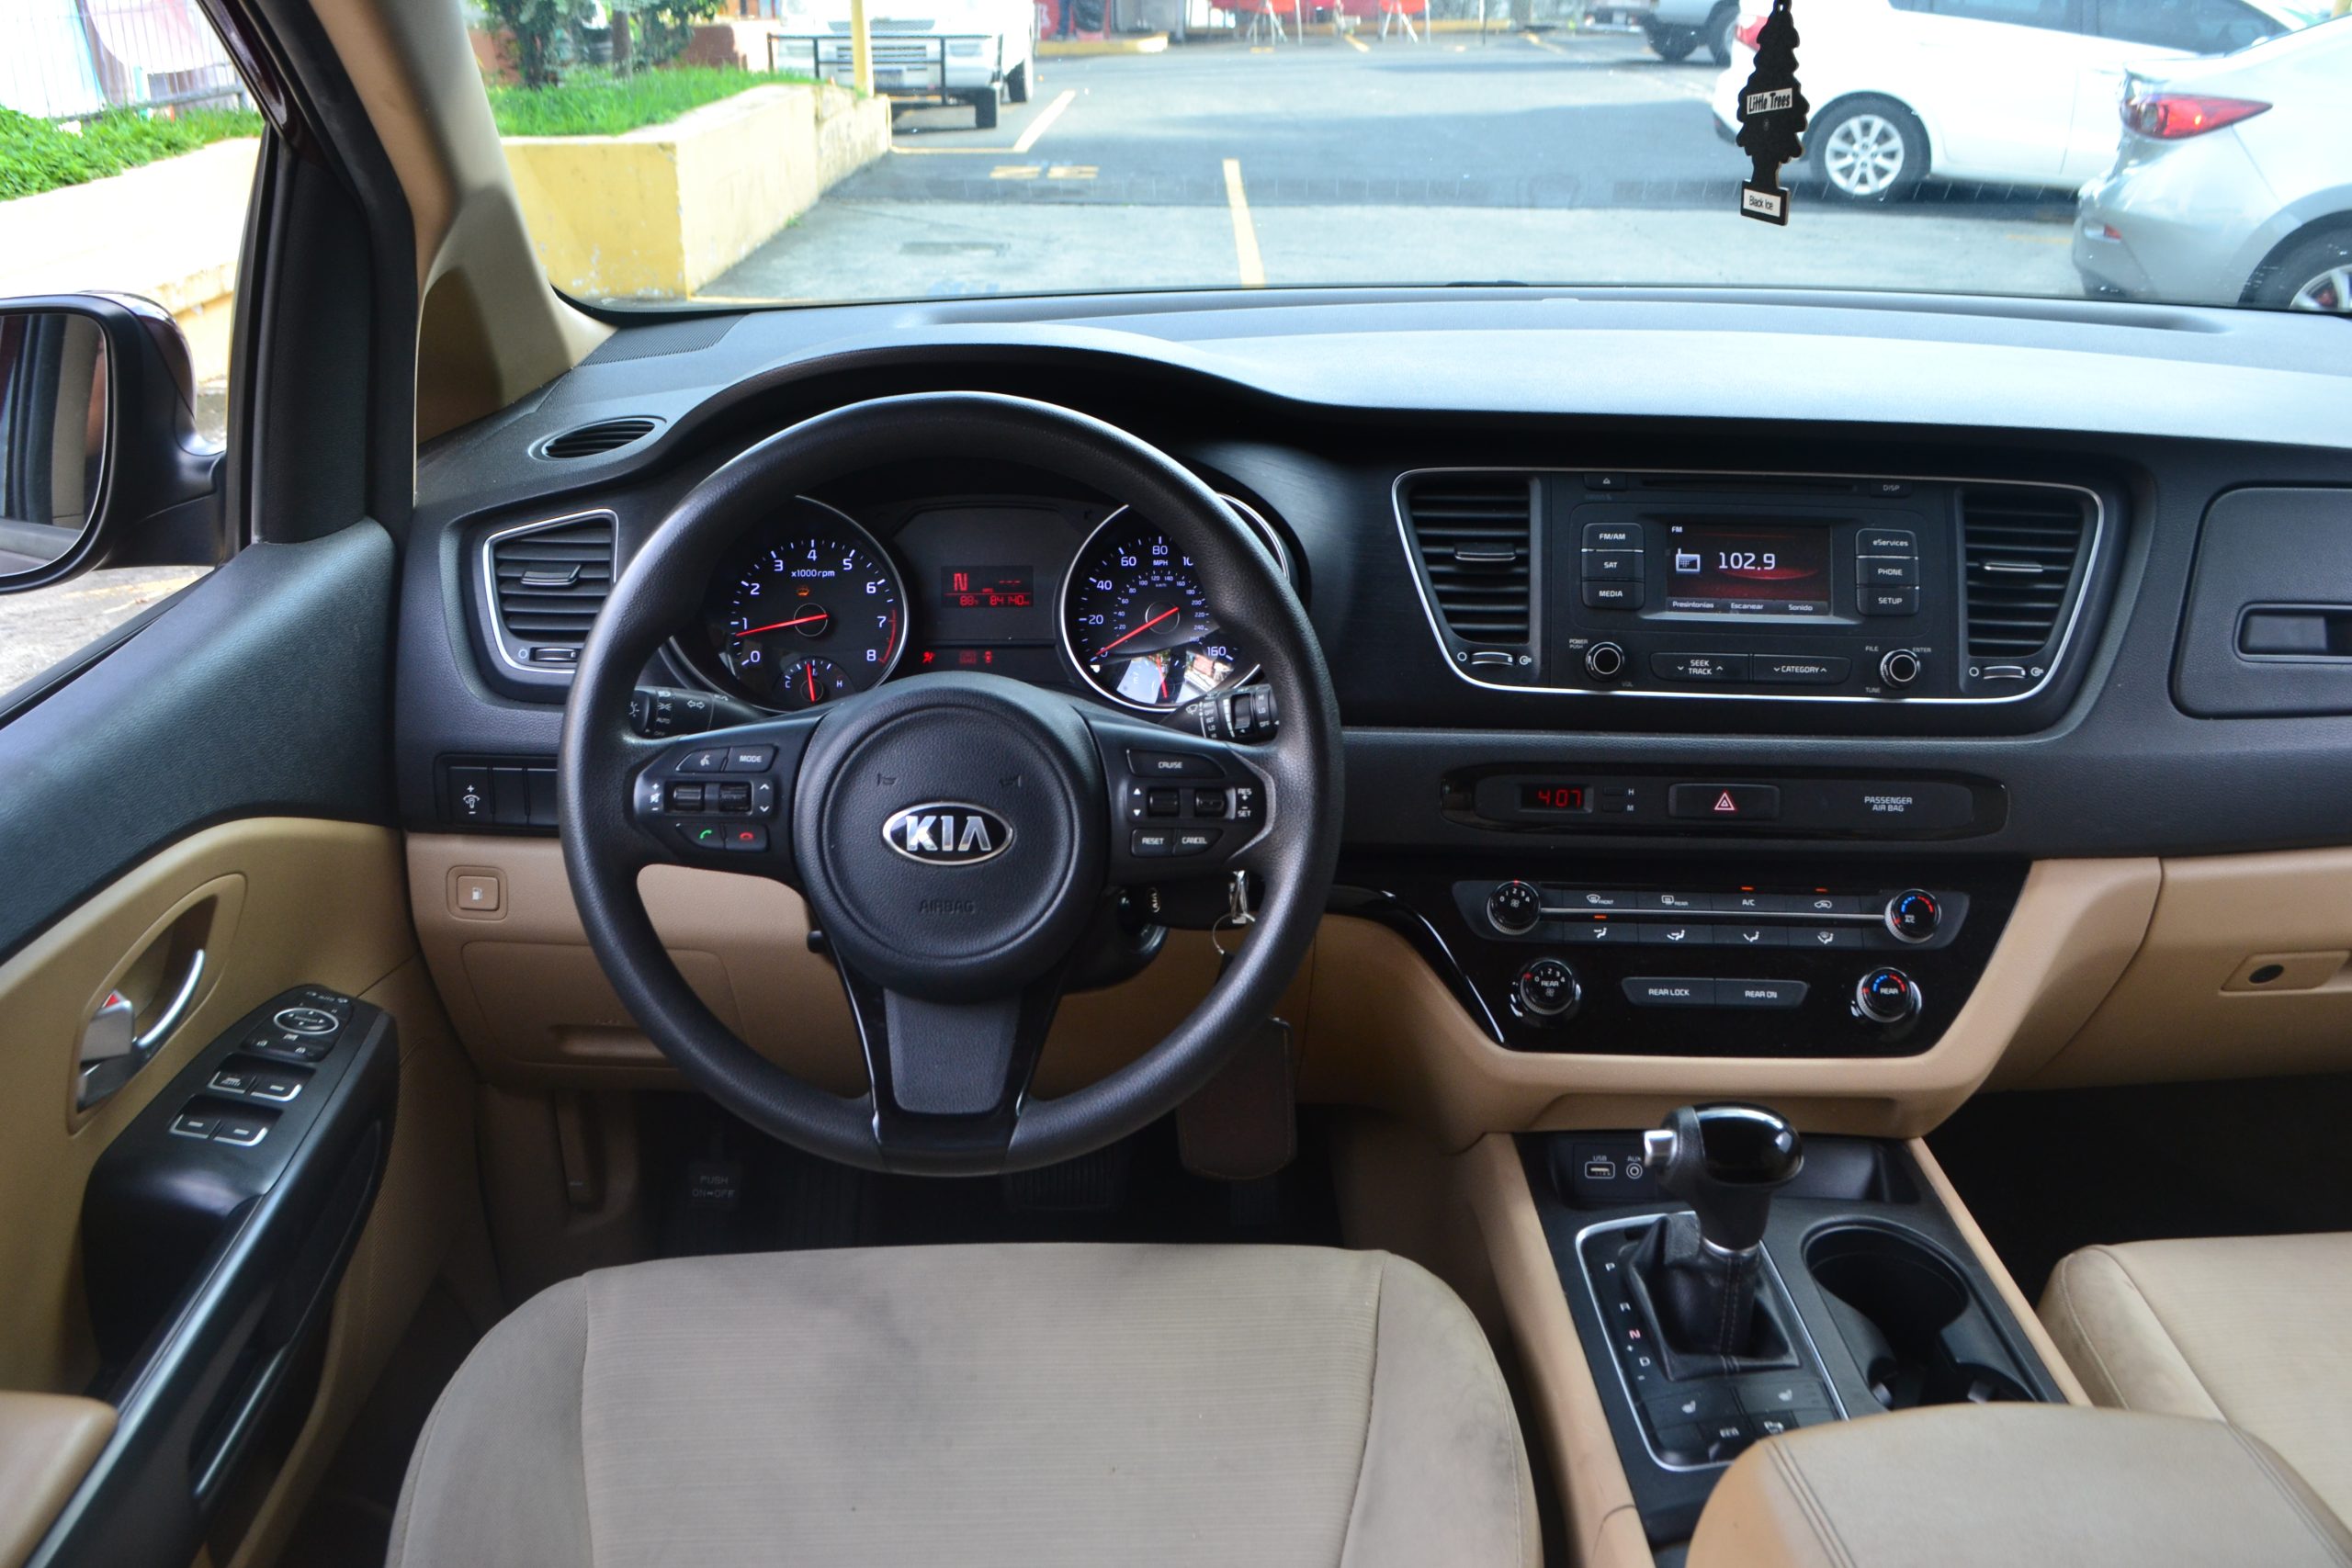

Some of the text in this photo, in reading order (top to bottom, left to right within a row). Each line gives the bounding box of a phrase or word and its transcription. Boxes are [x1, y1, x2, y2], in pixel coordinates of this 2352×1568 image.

[1748, 92, 1791, 113] Little Trees
[1749, 195, 1773, 211] Black Ice
[807, 550, 818, 561] 4
[1152, 545, 1168, 555] 80
[774, 560, 784, 572] 3
[843, 558, 852, 570] 5
[1121, 556, 1136, 566] 60
[1719, 552, 1775, 570] 102.9
[954, 573, 967, 591] N
[1097, 580, 1112, 590] 40
[750, 584, 760, 595] 2
[866, 582, 876, 594] 6
[742, 618, 748, 629] 1
[877, 616, 886, 628] 7
[1089, 615, 1104, 624] 20
[750, 651, 760, 662] 0
[866, 649, 876, 661] 8
[1207, 646, 1226, 656] 160
[1864, 796, 1912, 804] PASSENGER
[906, 815, 992, 852] KIA
[919, 900, 975, 914] AIRBAG
[1605, 1262, 1615, 1271] P
[1629, 1329, 1641, 1339] N
[1639, 1356, 1651, 1367] D
